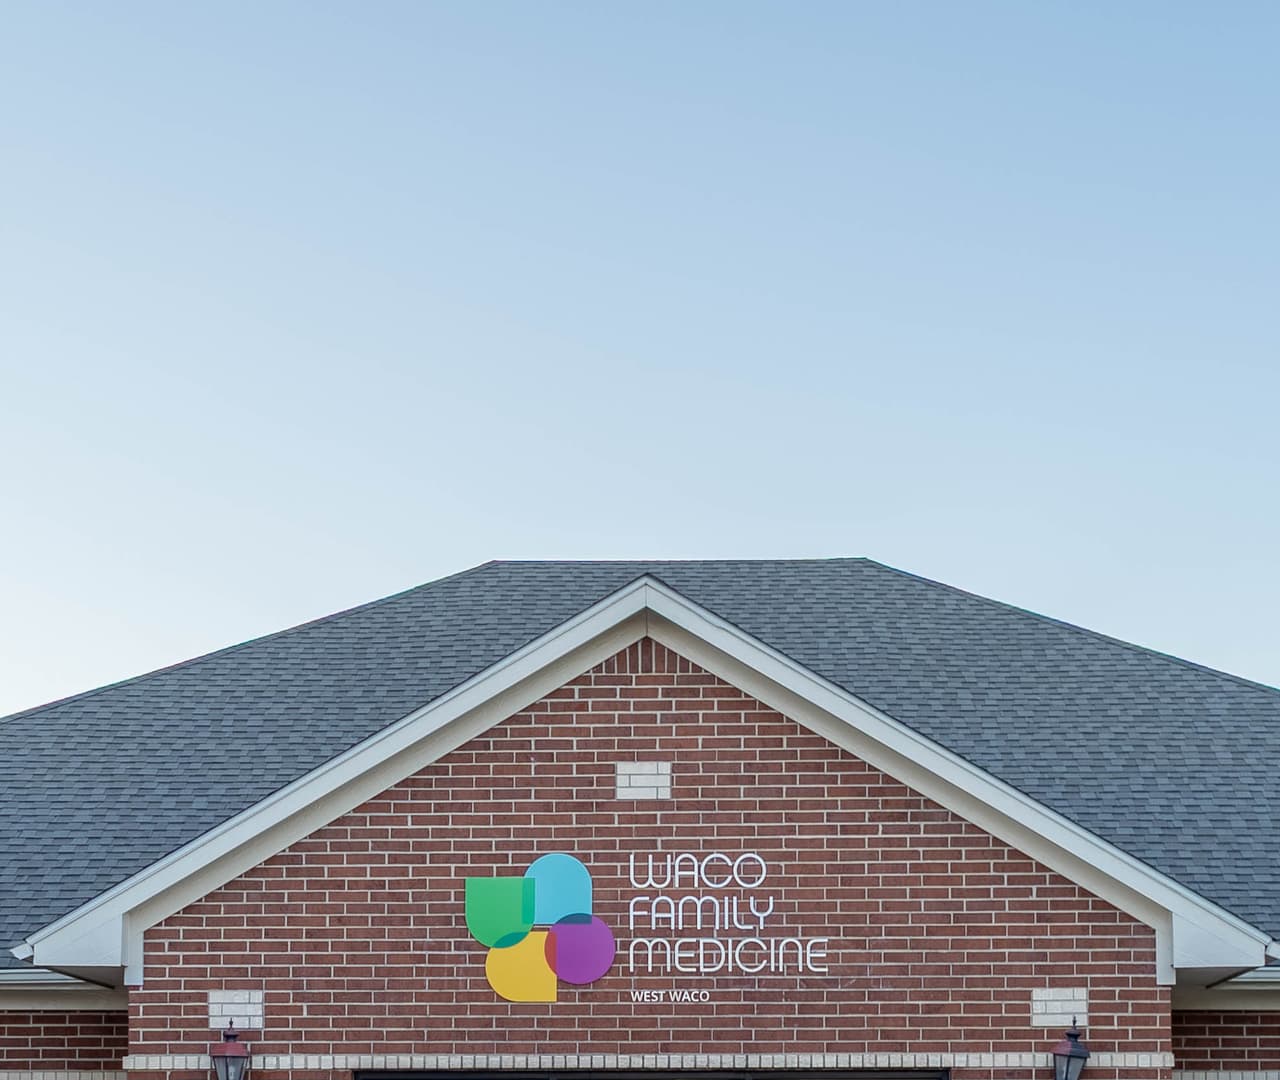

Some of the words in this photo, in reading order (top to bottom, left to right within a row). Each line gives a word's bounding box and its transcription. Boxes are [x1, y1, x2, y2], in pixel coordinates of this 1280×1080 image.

[629, 853, 767, 888] WACO
[629, 896, 774, 930] FAMILY
[629, 938, 829, 973] MEDICINE
[630, 991, 665, 1002] WEST
[669, 991, 710, 1002] WACO
